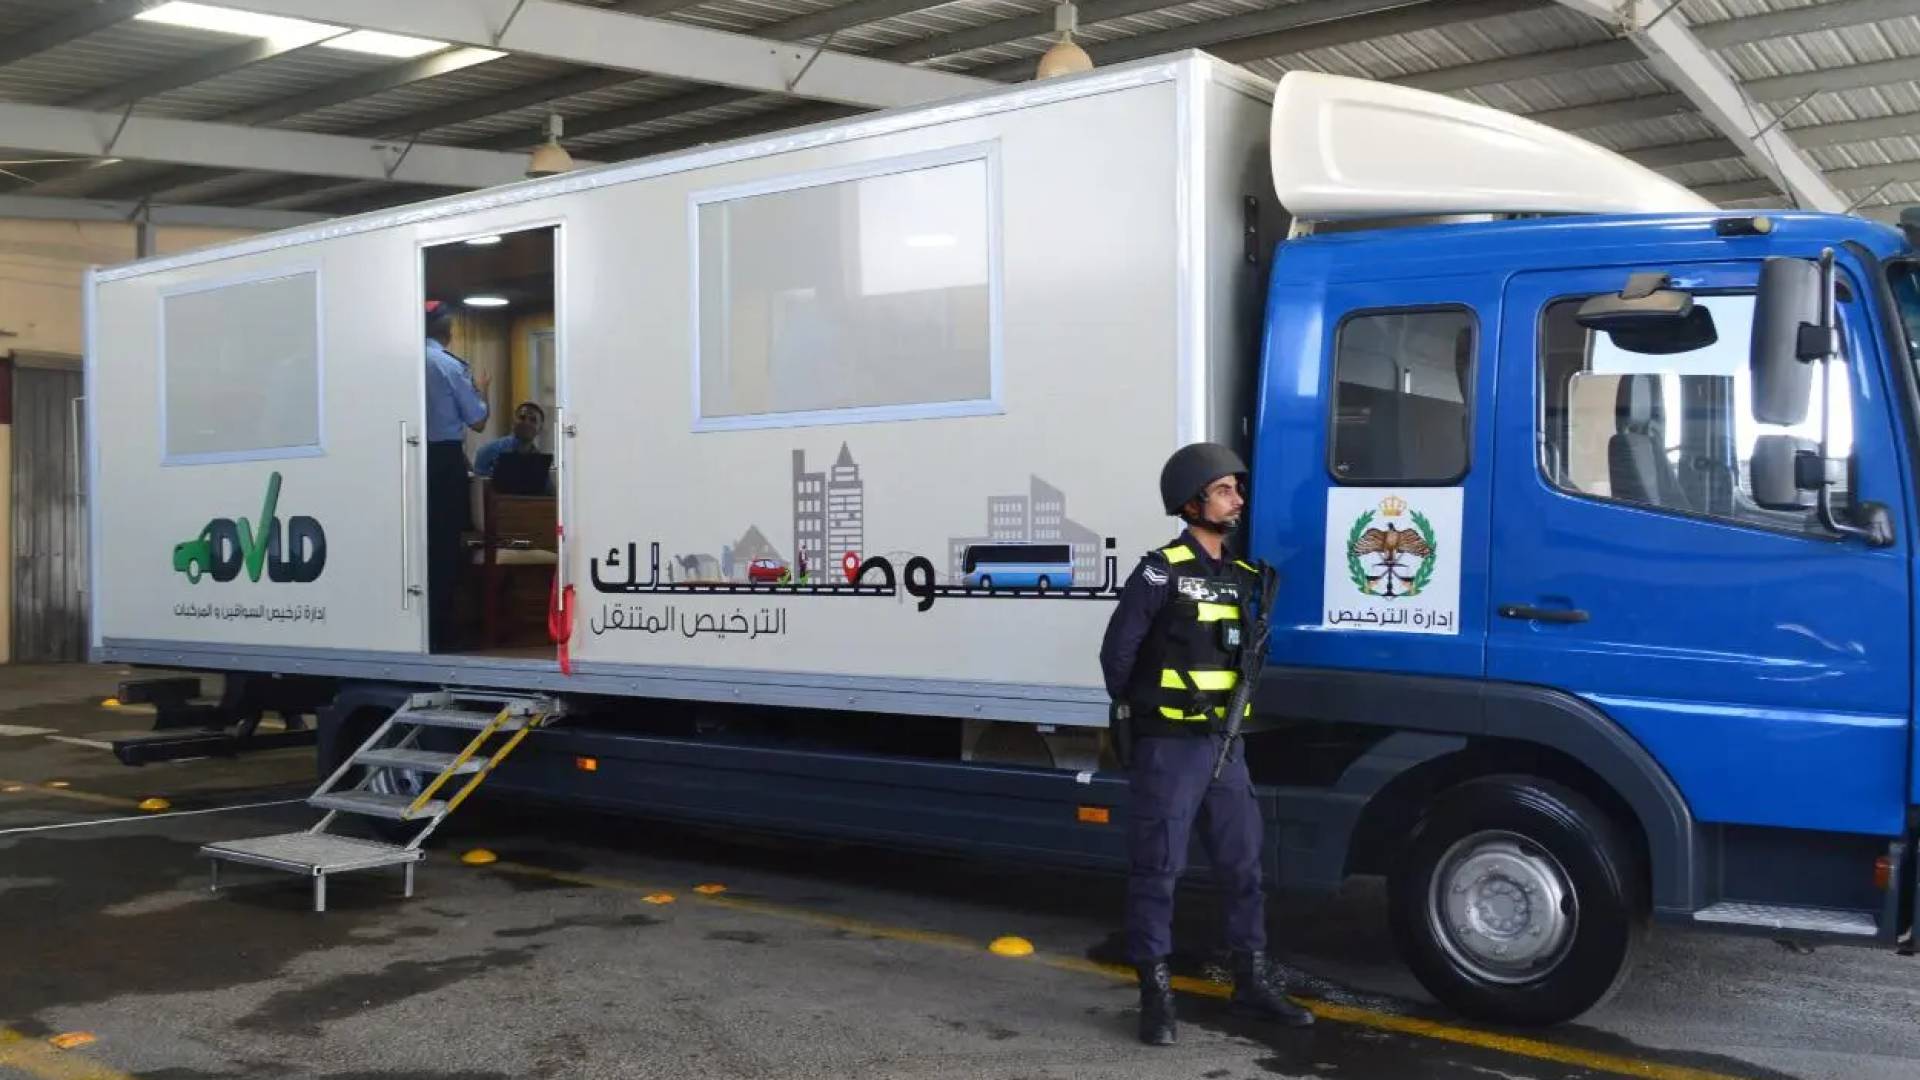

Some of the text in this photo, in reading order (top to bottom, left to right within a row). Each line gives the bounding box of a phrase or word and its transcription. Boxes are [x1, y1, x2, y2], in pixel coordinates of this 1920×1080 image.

[208, 471, 327, 583] DVLD
[173, 603, 213, 620] المركبات
[223, 603, 265, 622] السواقين
[266, 605, 302, 623] ترخيص
[304, 605, 326, 623] إدارة
[590, 602, 786, 640] الترخيص المتنقل
[1328, 606, 1453, 632] إدارة الترخيص
